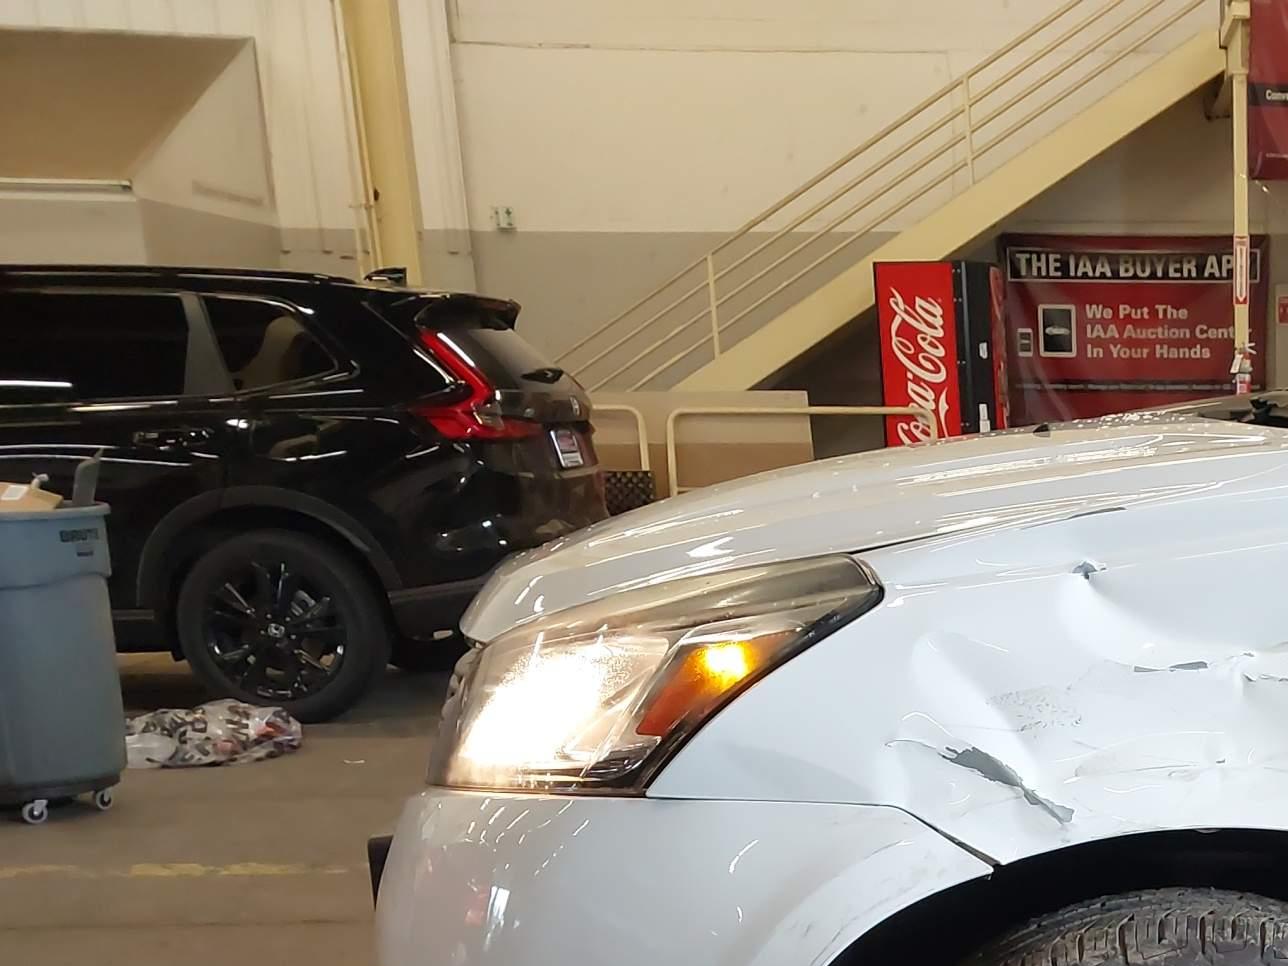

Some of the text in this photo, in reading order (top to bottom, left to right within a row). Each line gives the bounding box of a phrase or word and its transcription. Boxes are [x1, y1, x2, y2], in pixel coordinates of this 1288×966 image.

[1015, 253, 1234, 278] THE IAA BUYER AP
[1086, 304, 1188, 319] We Put The
[1086, 324, 1253, 339] IAA Auction Cent
[1087, 344, 1211, 359] In Your Hands
[889, 286, 949, 446] Coa-Cola
